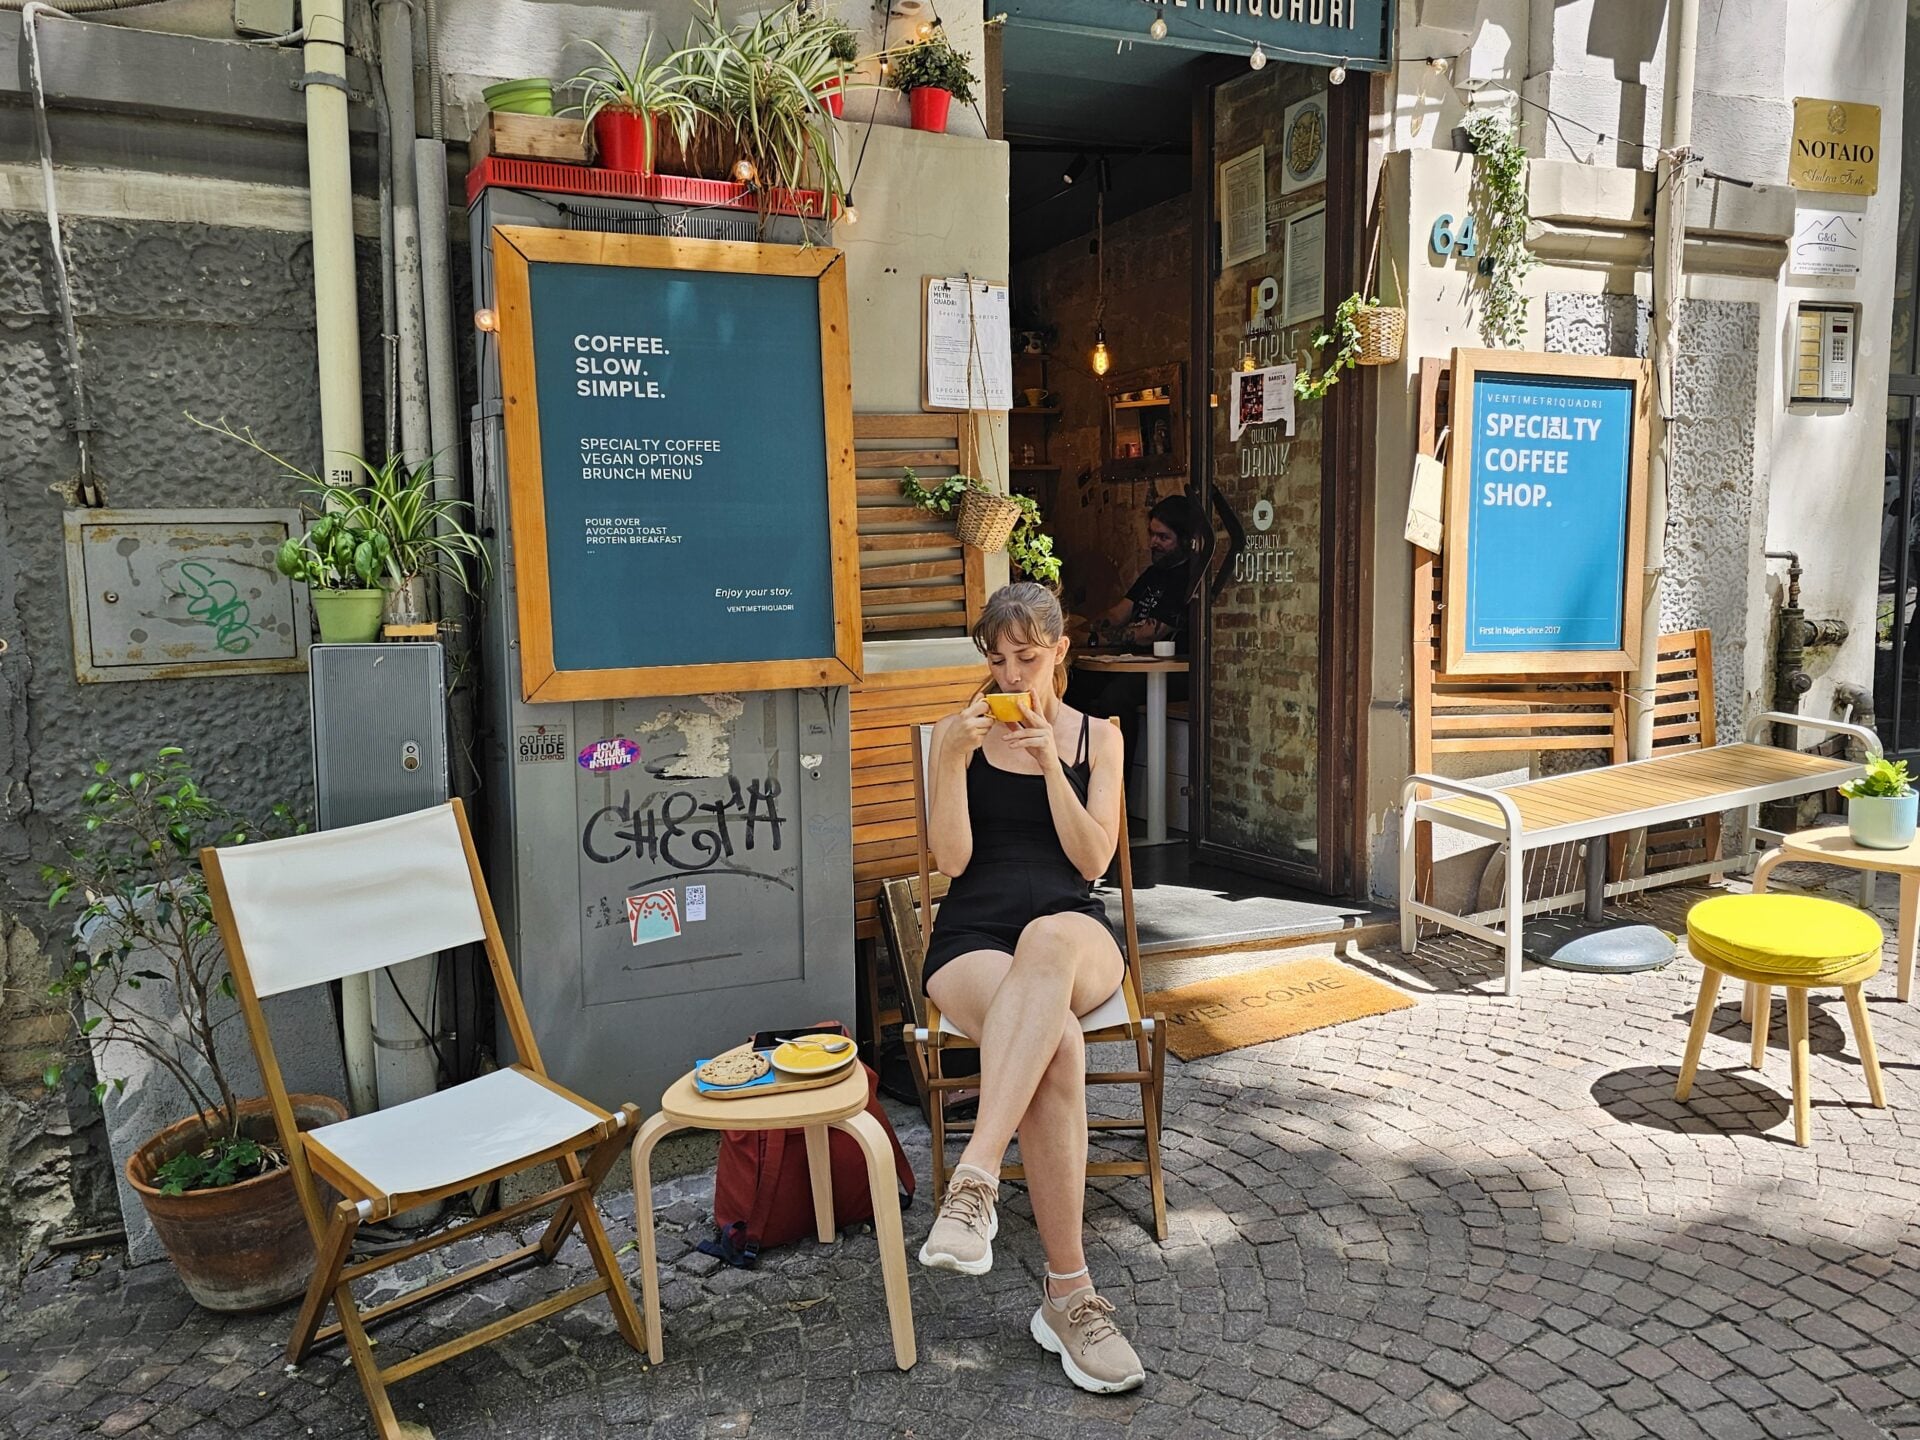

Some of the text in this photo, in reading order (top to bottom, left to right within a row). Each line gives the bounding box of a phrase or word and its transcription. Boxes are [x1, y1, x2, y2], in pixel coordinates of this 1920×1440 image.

[1797, 139, 1874, 164] NOTAIO
[1430, 213, 1478, 257] 64
[1818, 232, 1837, 243] G&G
[574, 334, 670, 355] COFFEE.
[575, 357, 648, 376] SLOW.
[577, 379, 666, 398] SIMPLE.
[1487, 392, 1603, 409] VENTIMETRIQUADRI
[1486, 413, 1602, 442] SPECIALTY
[1251, 427, 1278, 445] QUALITY
[580, 438, 721, 452] SPECIALTY COFFEE
[581, 453, 703, 466] VEGAN OPTIONS
[1240, 443, 1291, 478] DRINK
[1485, 448, 1569, 474] COFFEE
[582, 468, 693, 481] BRUNCH MENU
[1483, 483, 1552, 508] SHOP.
[585, 518, 640, 527] POUR OVER
[585, 527, 667, 535] AVOCADO TOAST
[586, 535, 682, 545] PROTEIN BREAKFAST
[1246, 534, 1281, 550] SPECIALTY
[1235, 551, 1294, 583] COFFEE
[715, 587, 793, 599] Enjoy your stay.
[726, 604, 794, 613] VENTIMETRIQUADRI
[1480, 626, 1561, 636] First in Naples since 2017
[520, 734, 564, 745] COFFEE
[597, 740, 620, 751] LOVE
[520, 744, 565, 755] GUIDE
[593, 748, 626, 760] FUTURE
[589, 754, 632, 769] INSTITUTE
[1167, 977, 1345, 1026] WELCOME
